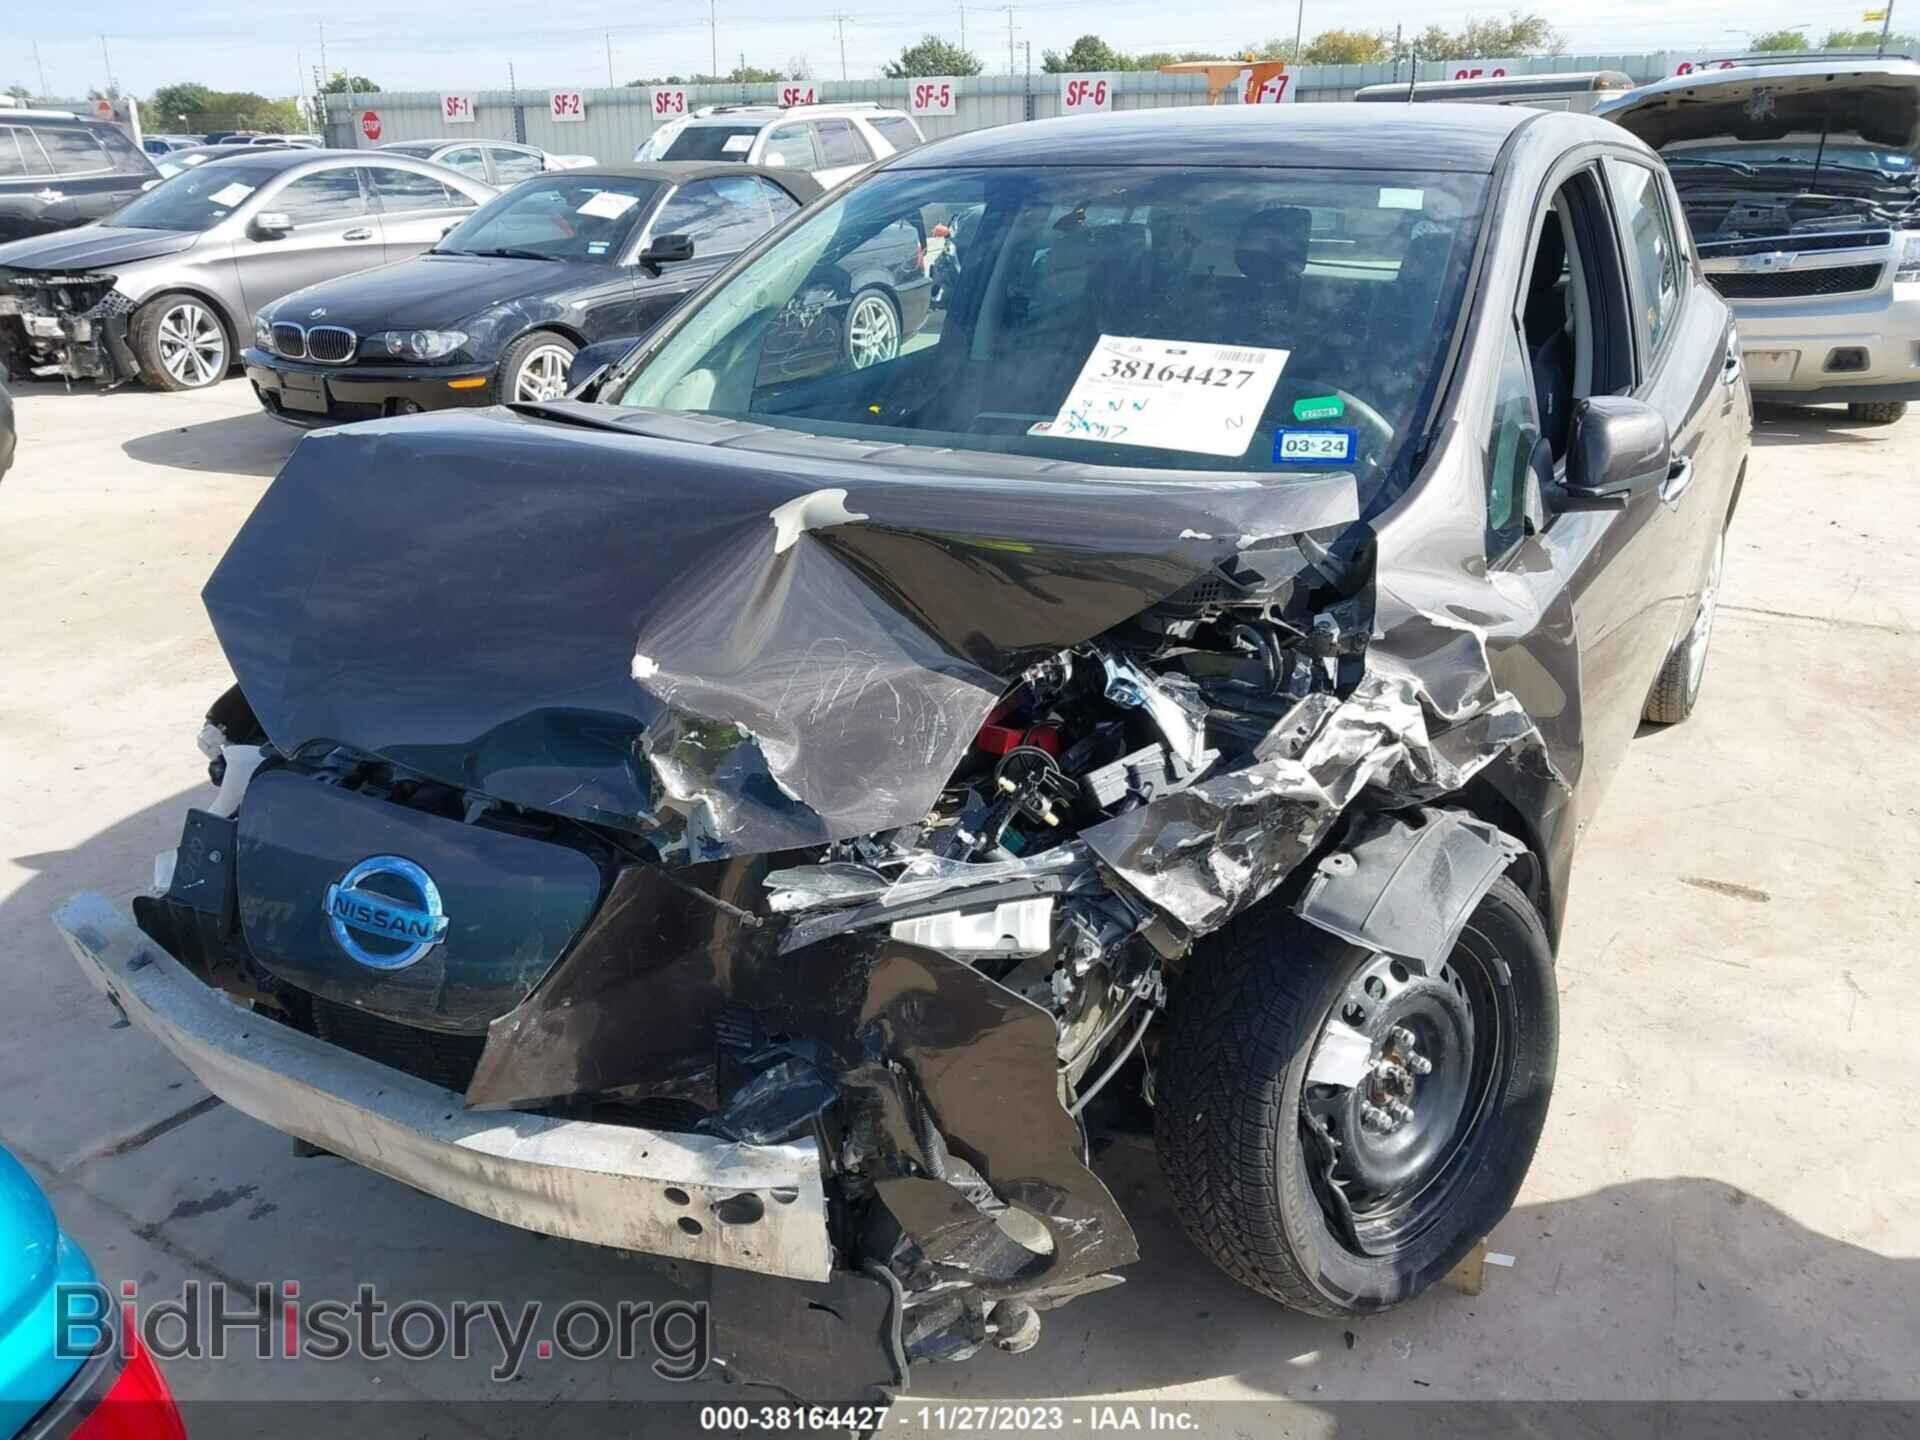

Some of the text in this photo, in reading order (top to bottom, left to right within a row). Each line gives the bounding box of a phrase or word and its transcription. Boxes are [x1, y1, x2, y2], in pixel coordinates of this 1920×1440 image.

[655, 92, 684, 114] SF-3
[783, 88, 814, 105] SF-4
[915, 84, 950, 108] SF-5
[1066, 79, 1107, 106] SF-6
[446, 97, 469, 116] SF-1
[554, 94, 580, 115] SF-2
[1101, 359, 1256, 389] 38164427
[1286, 439, 1345, 453] 03 24
[333, 896, 431, 938] NISSAN
